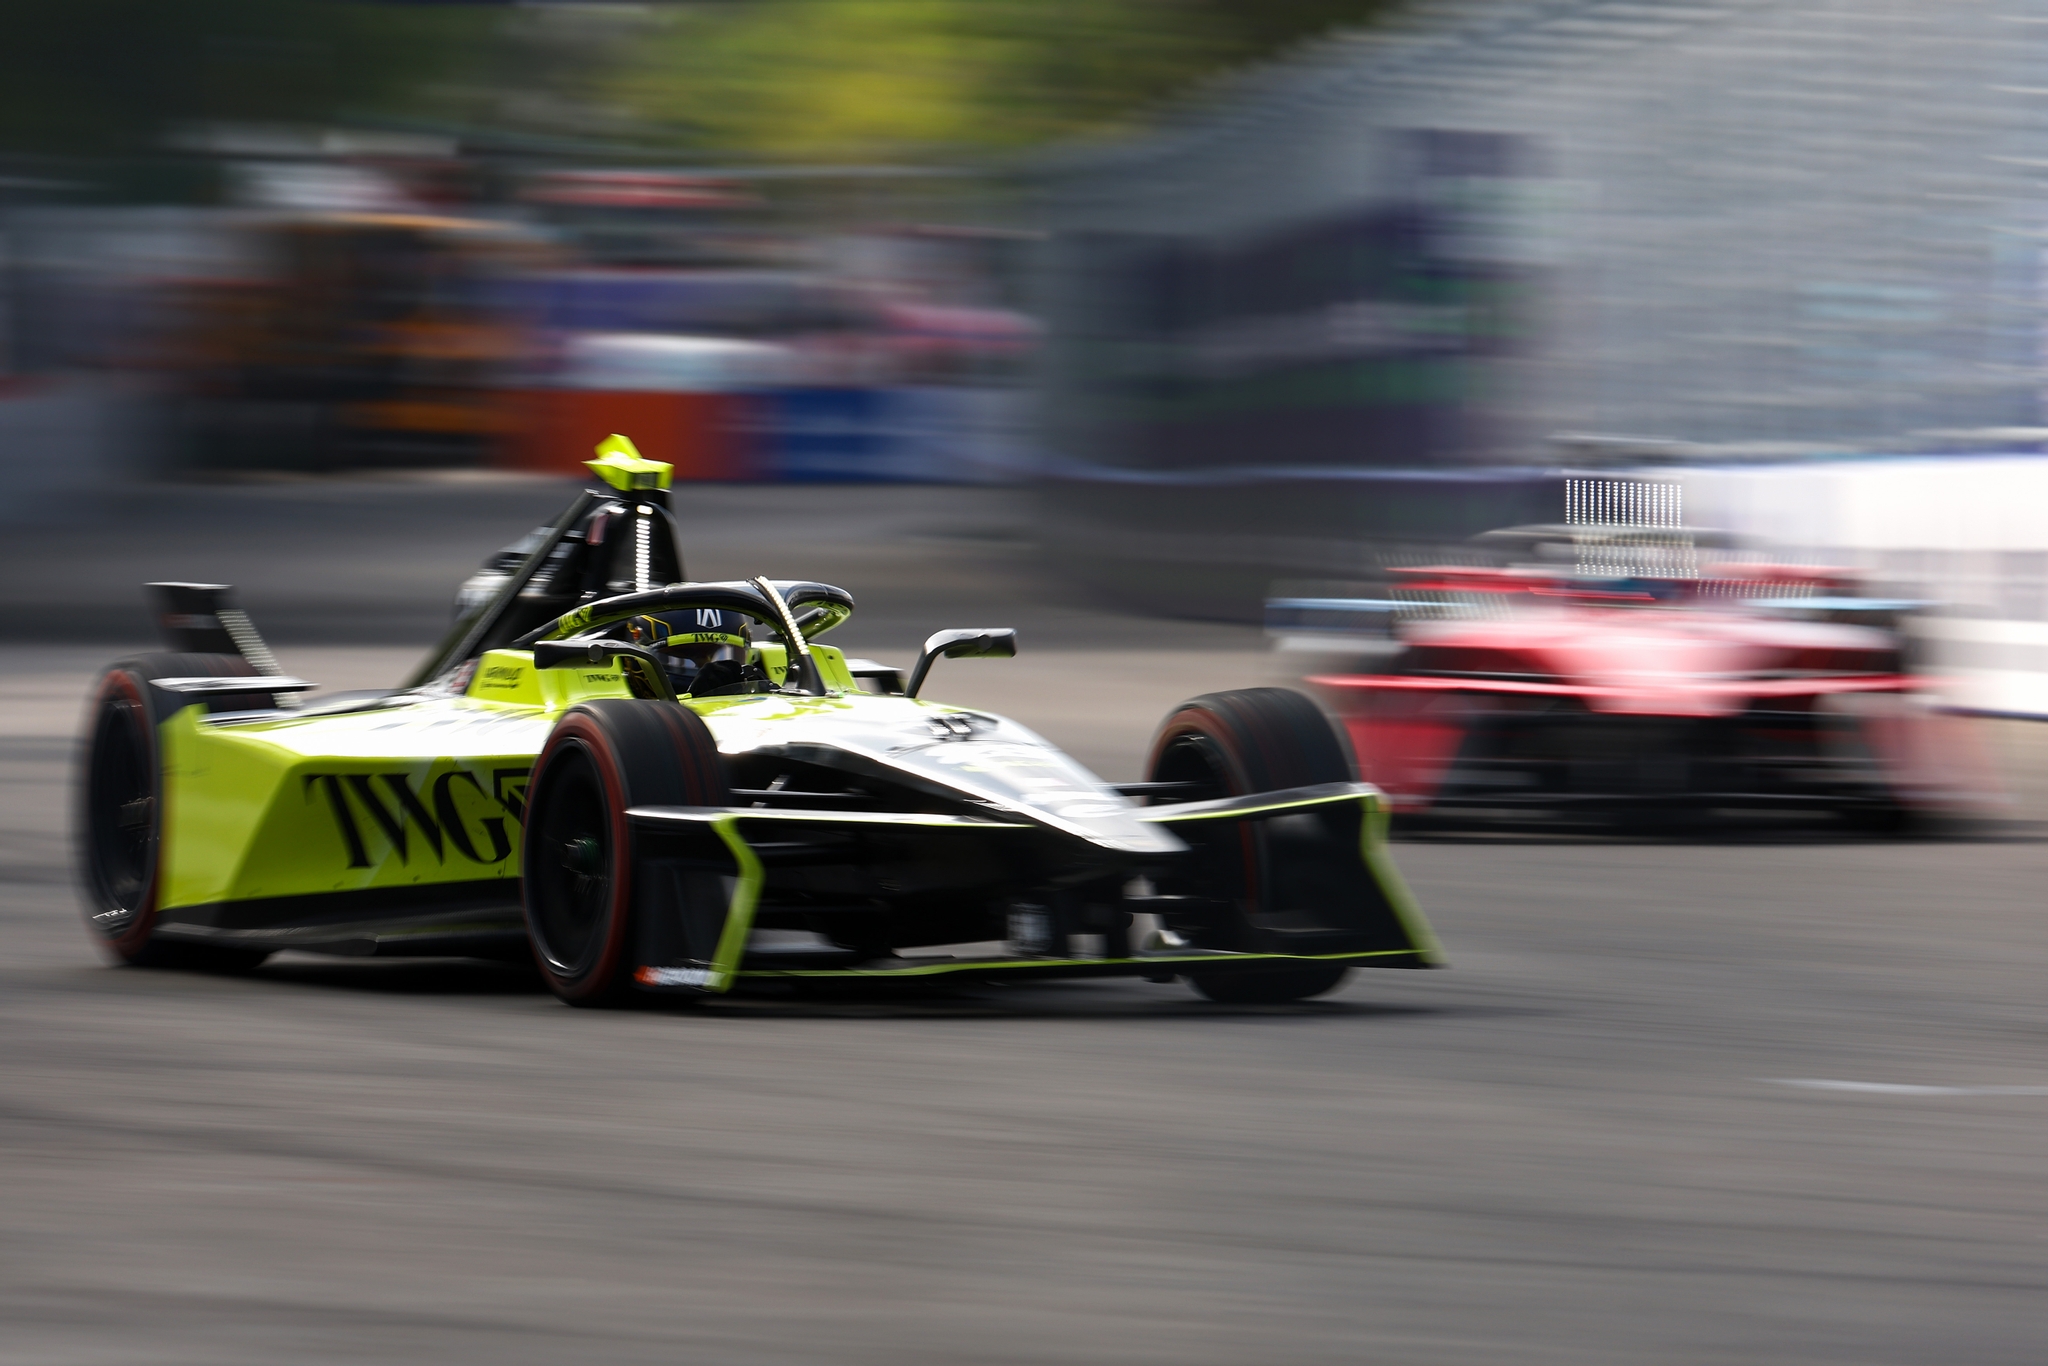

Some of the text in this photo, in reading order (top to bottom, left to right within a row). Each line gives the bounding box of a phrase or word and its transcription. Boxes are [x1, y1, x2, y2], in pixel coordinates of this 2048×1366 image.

[690, 633, 719, 643] TWG
[770, 665, 787, 675] TW
[301, 771, 512, 870] TWG
